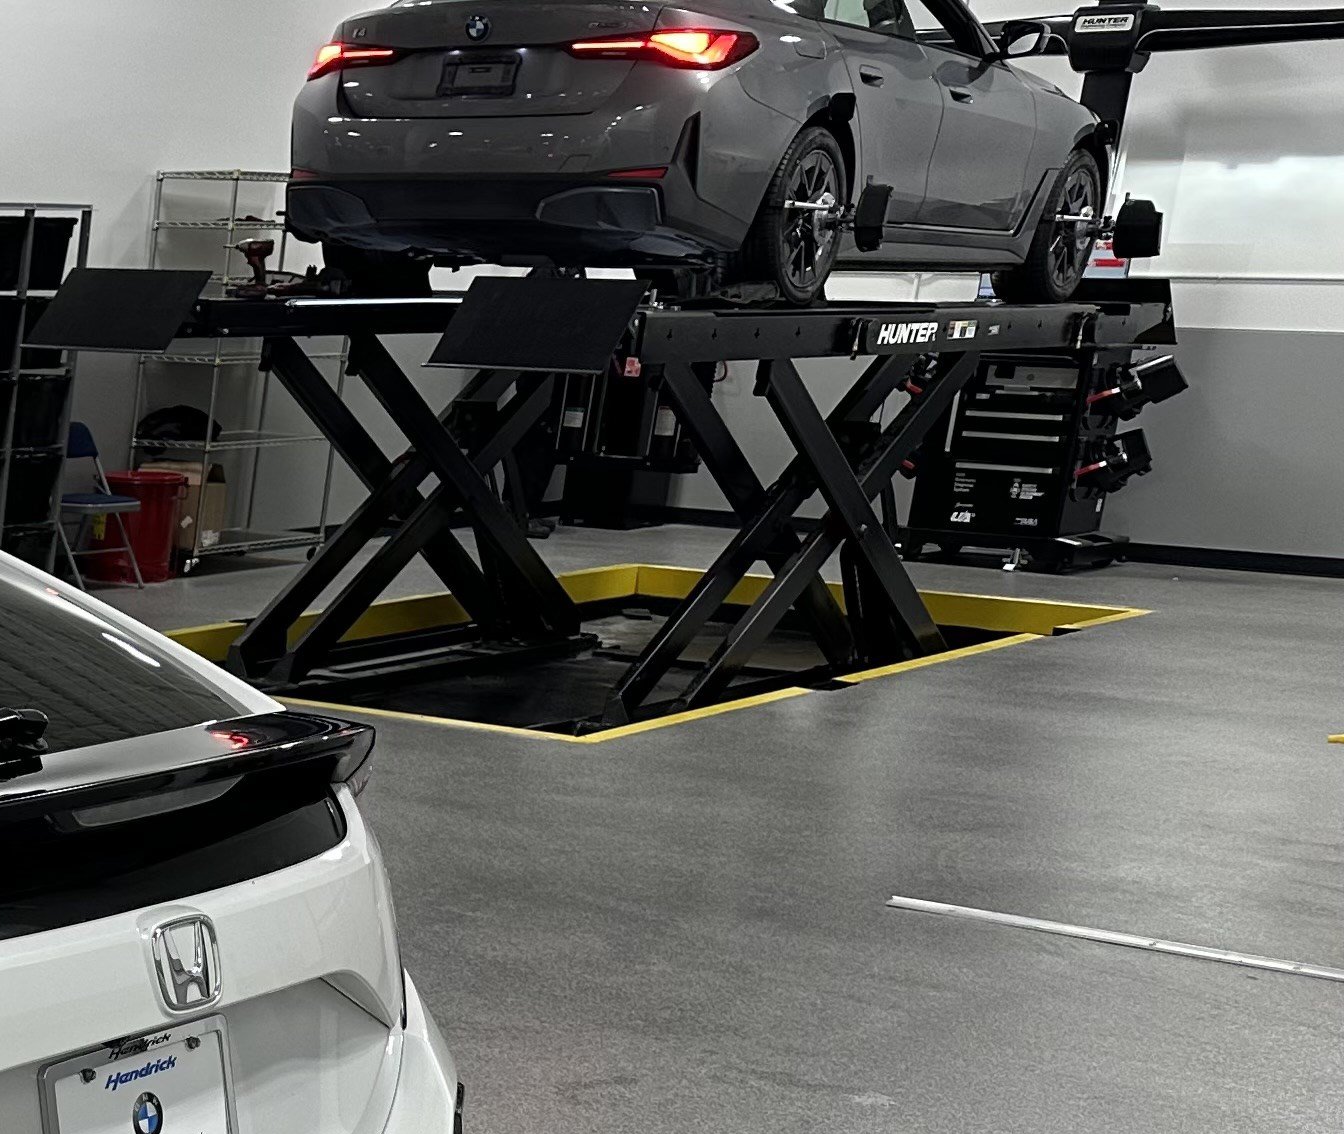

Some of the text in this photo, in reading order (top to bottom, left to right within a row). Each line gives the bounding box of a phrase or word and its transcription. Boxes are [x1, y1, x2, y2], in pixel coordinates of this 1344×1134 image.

[1082, 16, 1130, 25] HUNTER
[876, 322, 939, 345] HUNTER
[108, 1033, 172, 1061] Hendrick
[105, 1055, 178, 1092] Hendrick
